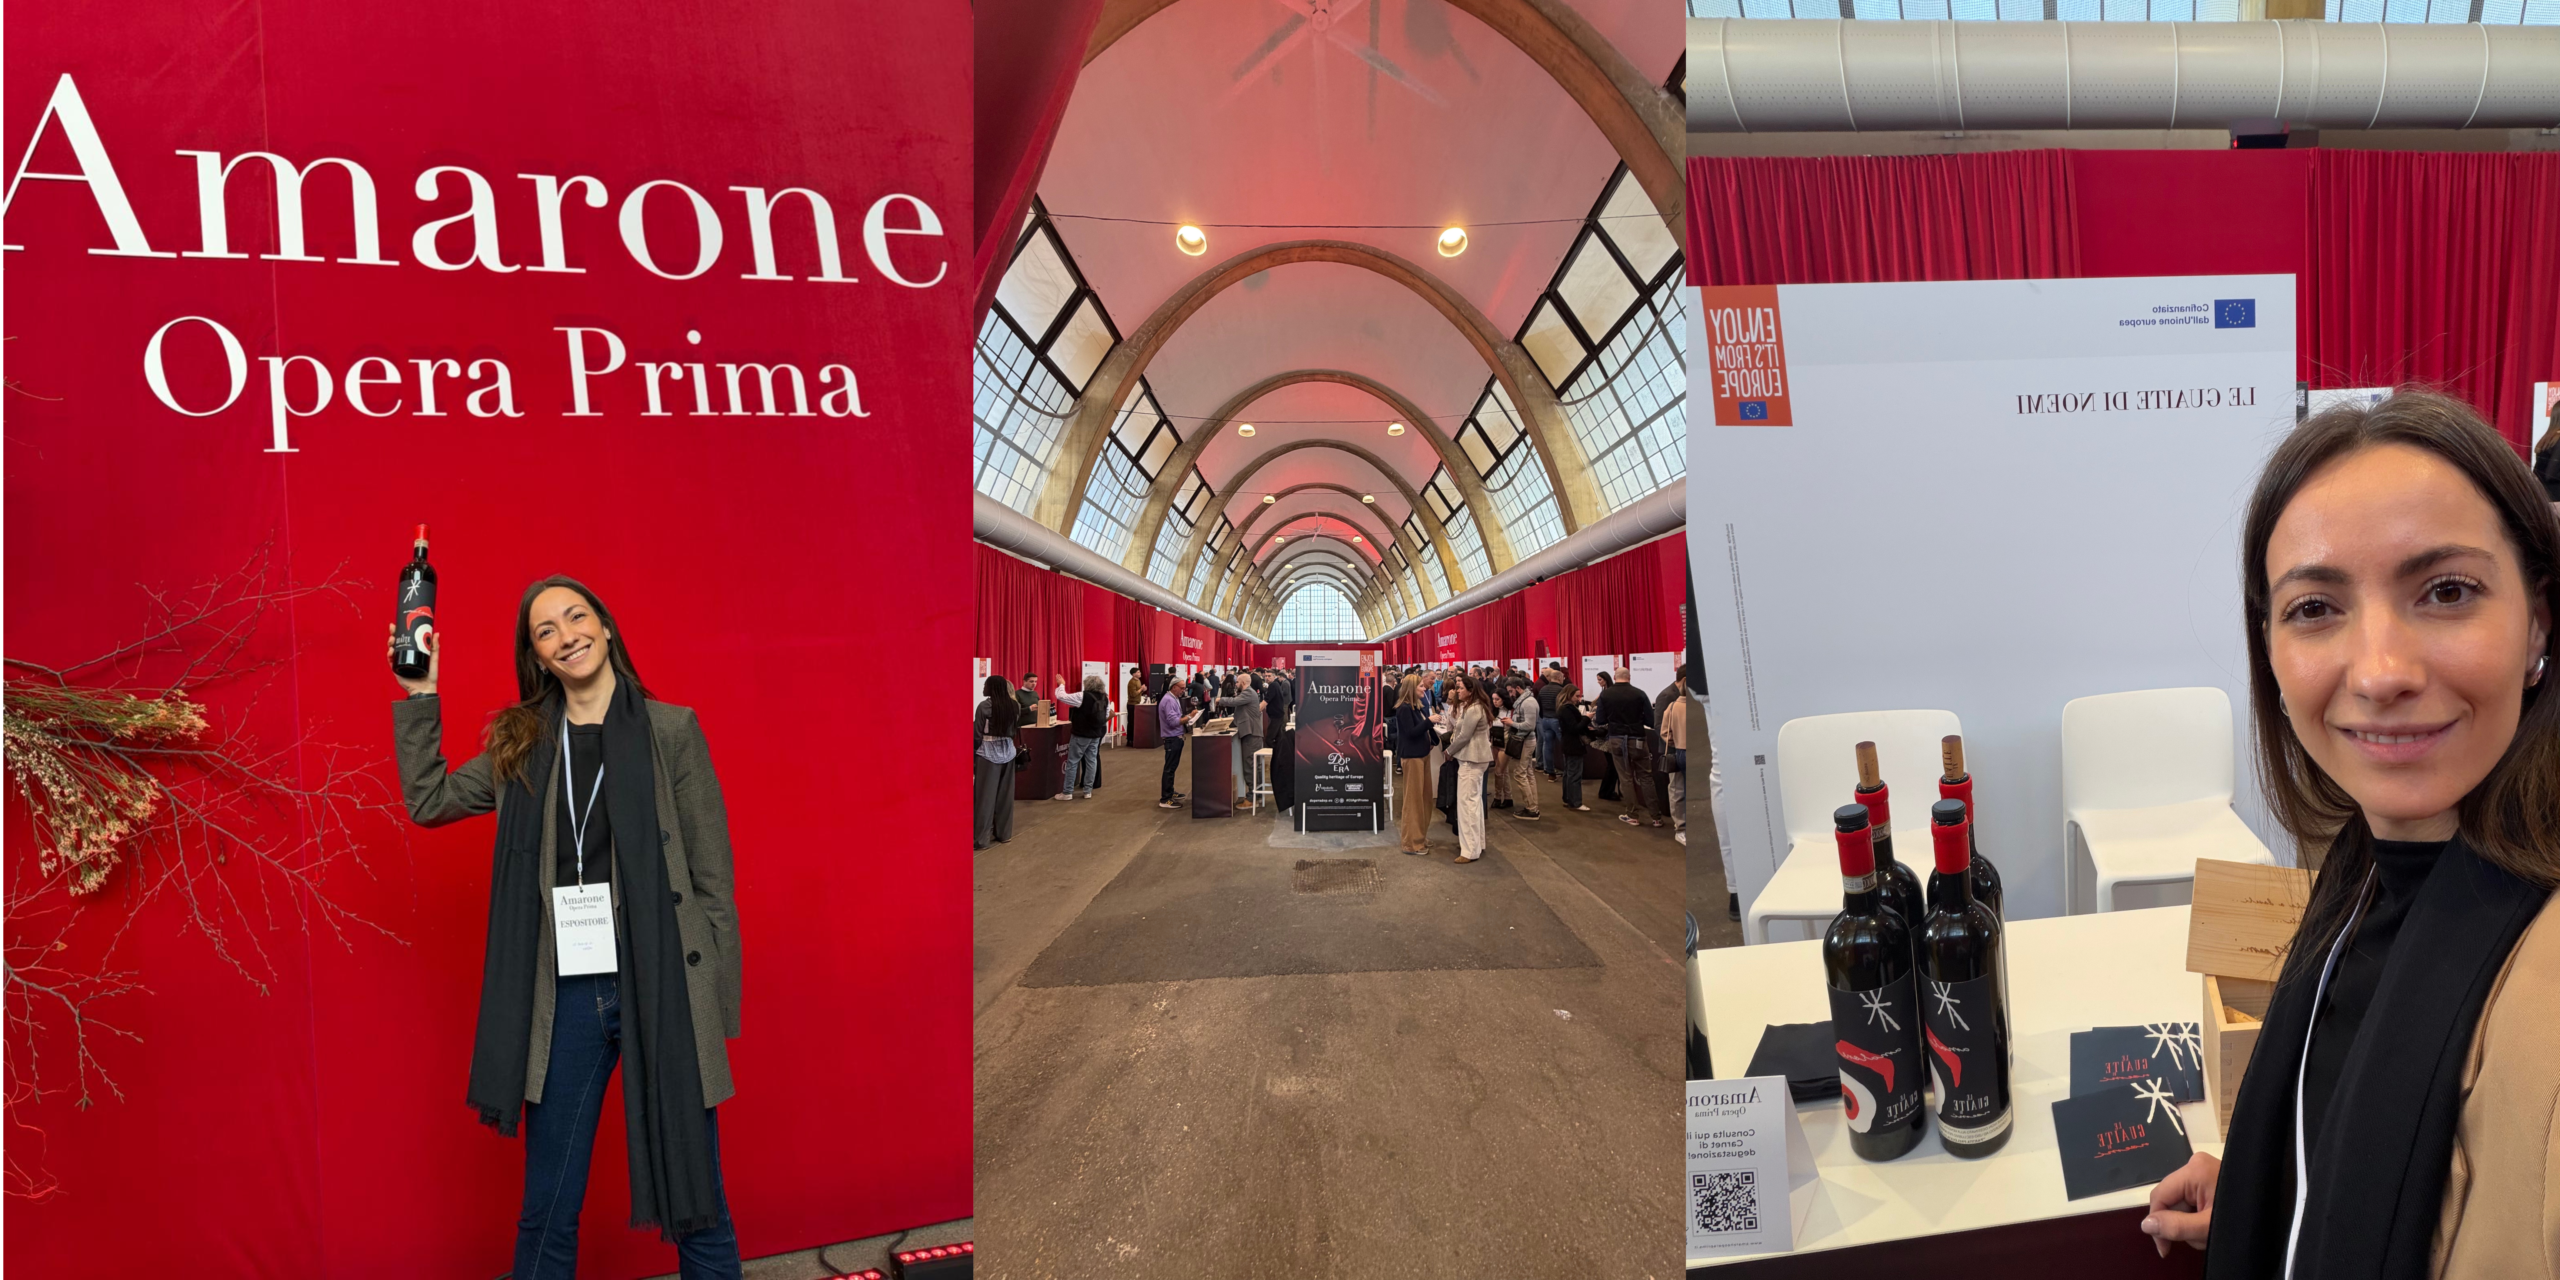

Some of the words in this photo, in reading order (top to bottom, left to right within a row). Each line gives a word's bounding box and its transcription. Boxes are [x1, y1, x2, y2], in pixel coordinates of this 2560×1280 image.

[2, 72, 949, 289] Amarone
[143, 315, 525, 453] Opera
[553, 326, 871, 419] Prima
[1307, 681, 1371, 694] Amarone
[1320, 695, 1338, 704] Opera
[561, 894, 604, 905] Amarone
[560, 916, 609, 928] ESPOSITORE
